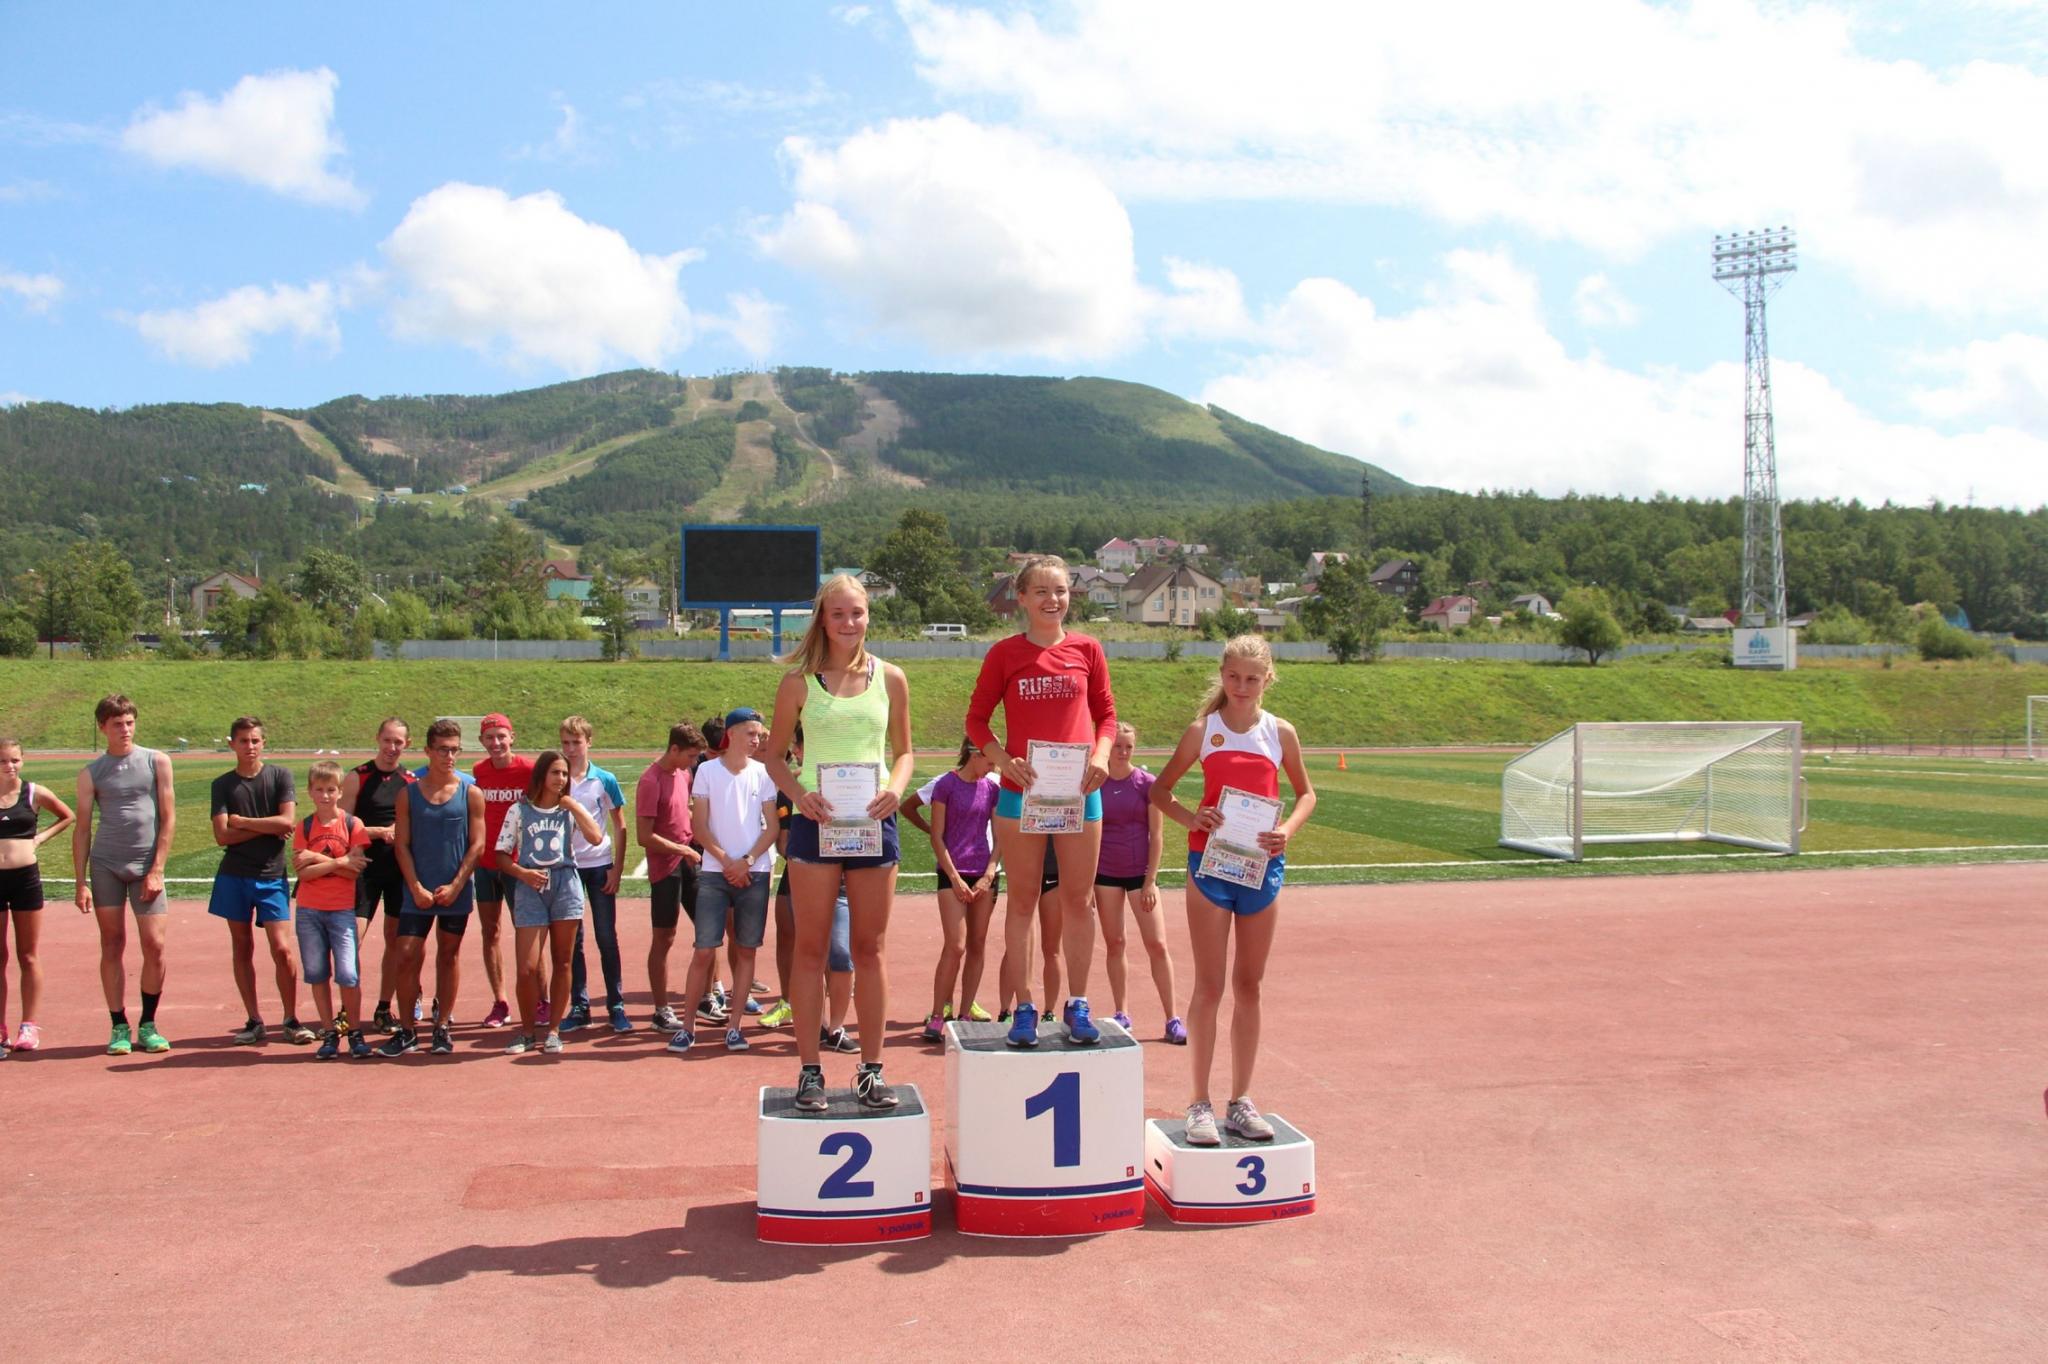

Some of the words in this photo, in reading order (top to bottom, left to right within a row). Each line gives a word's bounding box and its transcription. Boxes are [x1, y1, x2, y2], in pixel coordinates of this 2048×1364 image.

[1018, 676, 1078, 695] RUSSIA
[499, 789, 512, 801] DO
[1025, 1072, 1080, 1168] 1
[818, 1132, 874, 1199] 2
[1235, 1155, 1267, 1196] 3
